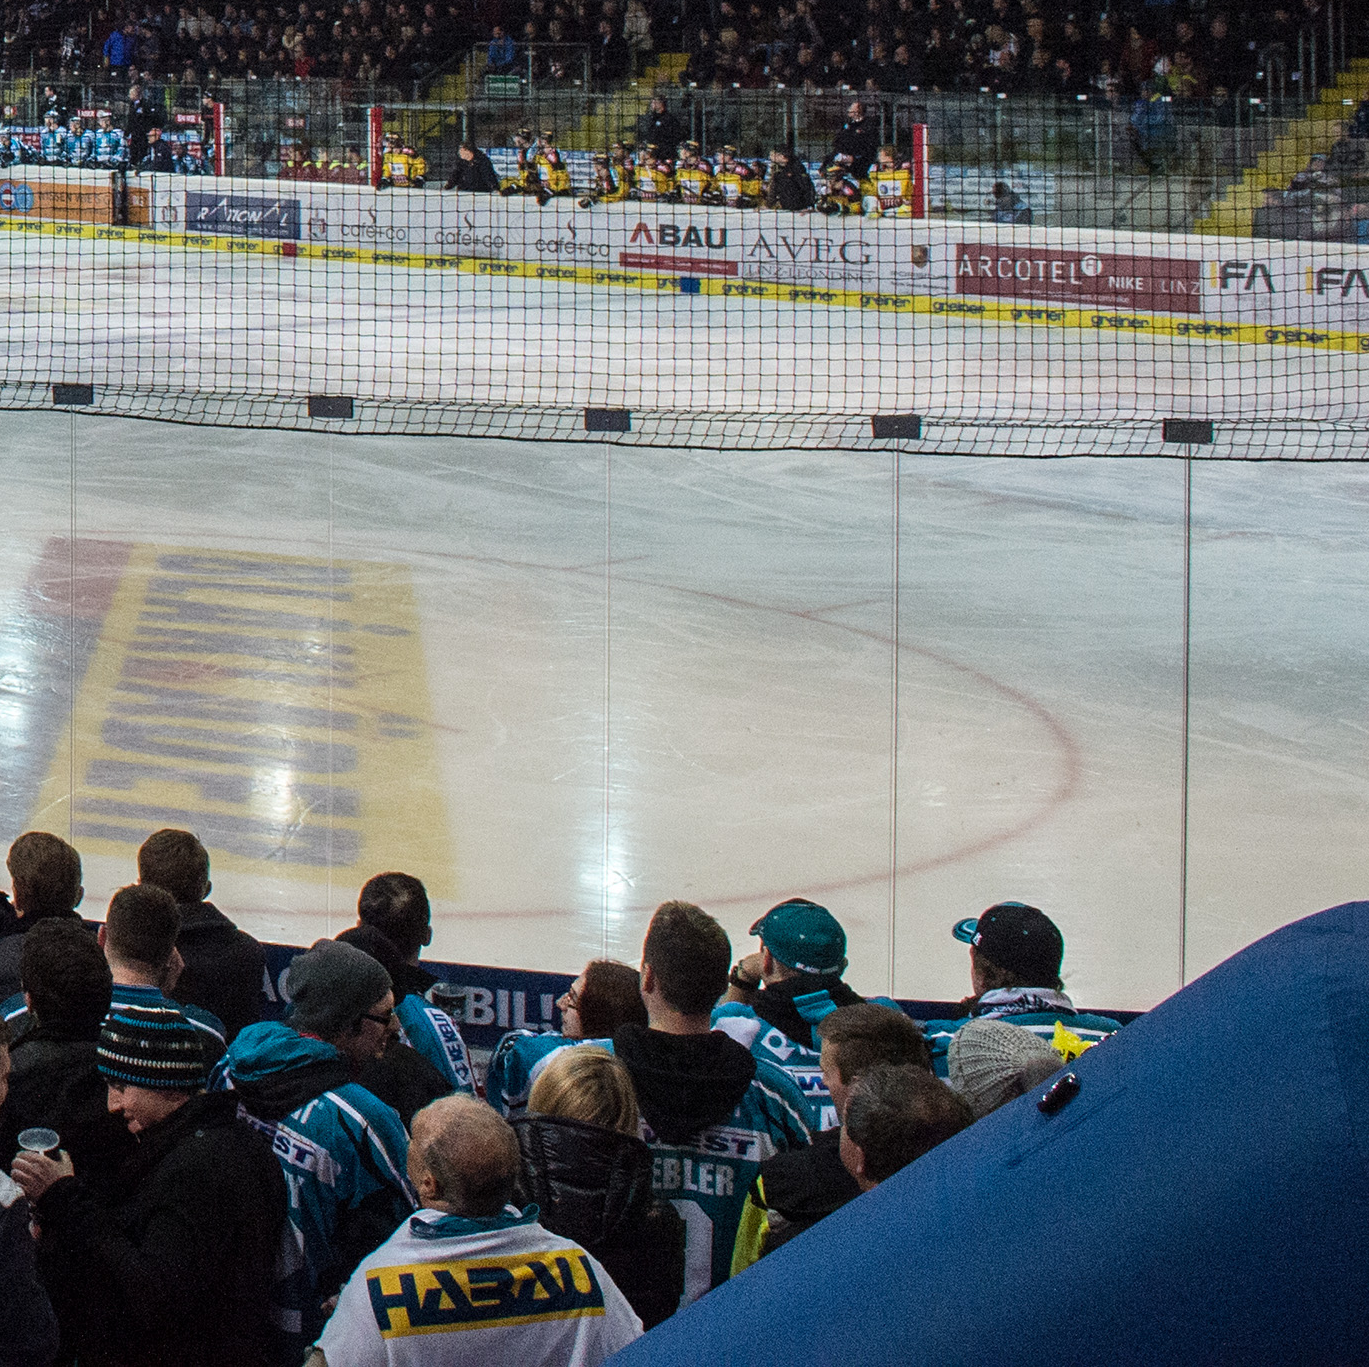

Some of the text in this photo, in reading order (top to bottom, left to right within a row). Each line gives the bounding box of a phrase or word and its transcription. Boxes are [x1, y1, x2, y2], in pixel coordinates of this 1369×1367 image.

[747, 234, 873, 265] AVEG
[479, 261, 519, 273] greiner
[958, 253, 1083, 286] ARCOTEL
[596, 272, 639, 284] greiner
[1108, 275, 1202, 296] NIKE LINZ
[722, 283, 768, 295] greiner
[788, 289, 838, 302] greiner
[861, 294, 912, 307] greiner
[1011, 308, 1065, 322] greiner
[1091, 313, 1151, 328] greiner
[463, 986, 554, 1031] BIL!
[652, 1156, 735, 1197] EBLER
[366, 1253, 605, 1332] HABAU
